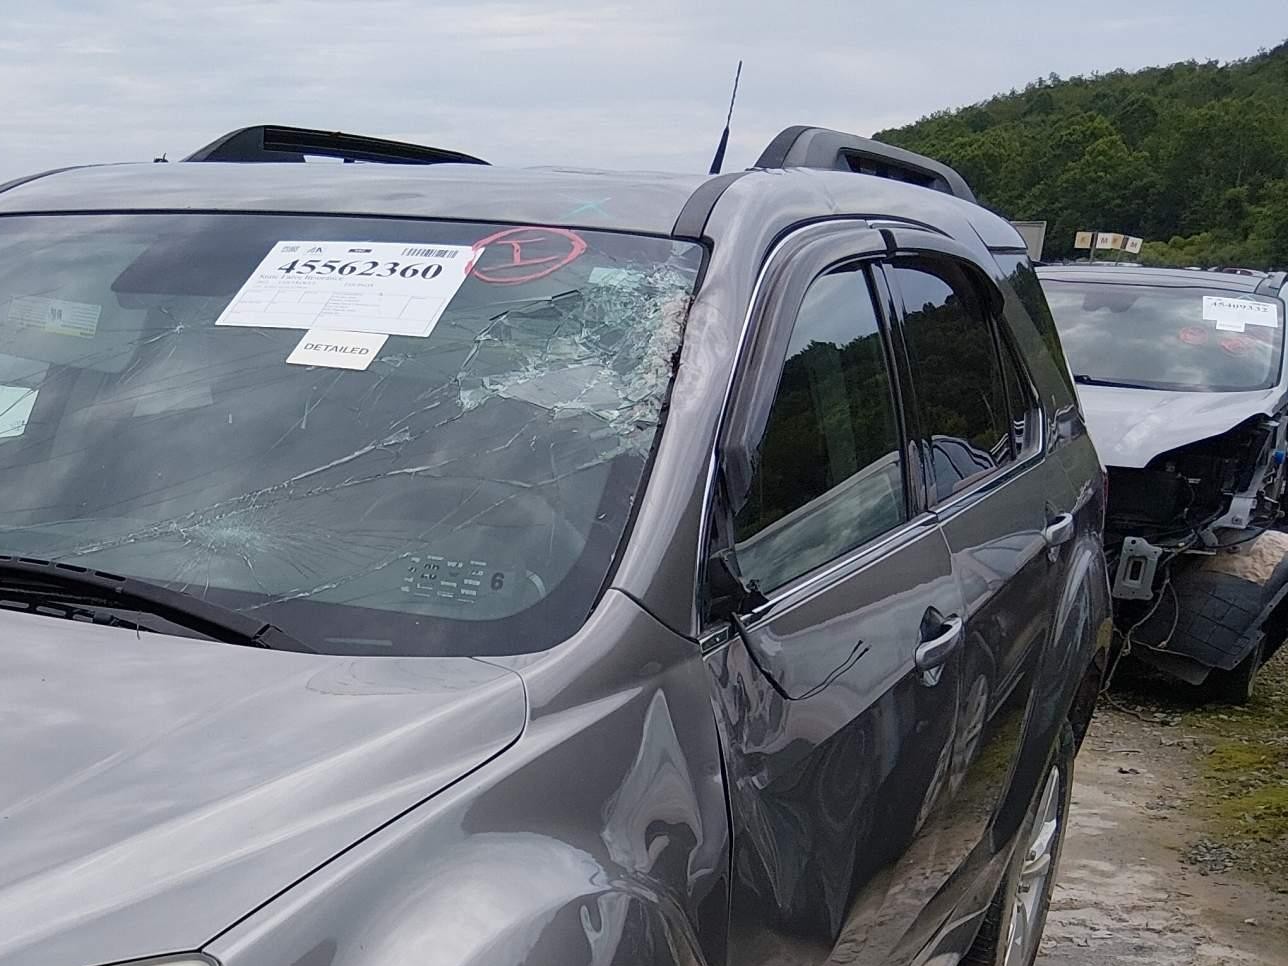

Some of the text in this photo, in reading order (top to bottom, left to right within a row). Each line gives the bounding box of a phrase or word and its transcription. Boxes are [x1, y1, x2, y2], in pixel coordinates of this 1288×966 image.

[277, 258, 443, 280] 45562360
[304, 342, 369, 355] DETAILED
[491, 572, 505, 590] 6
